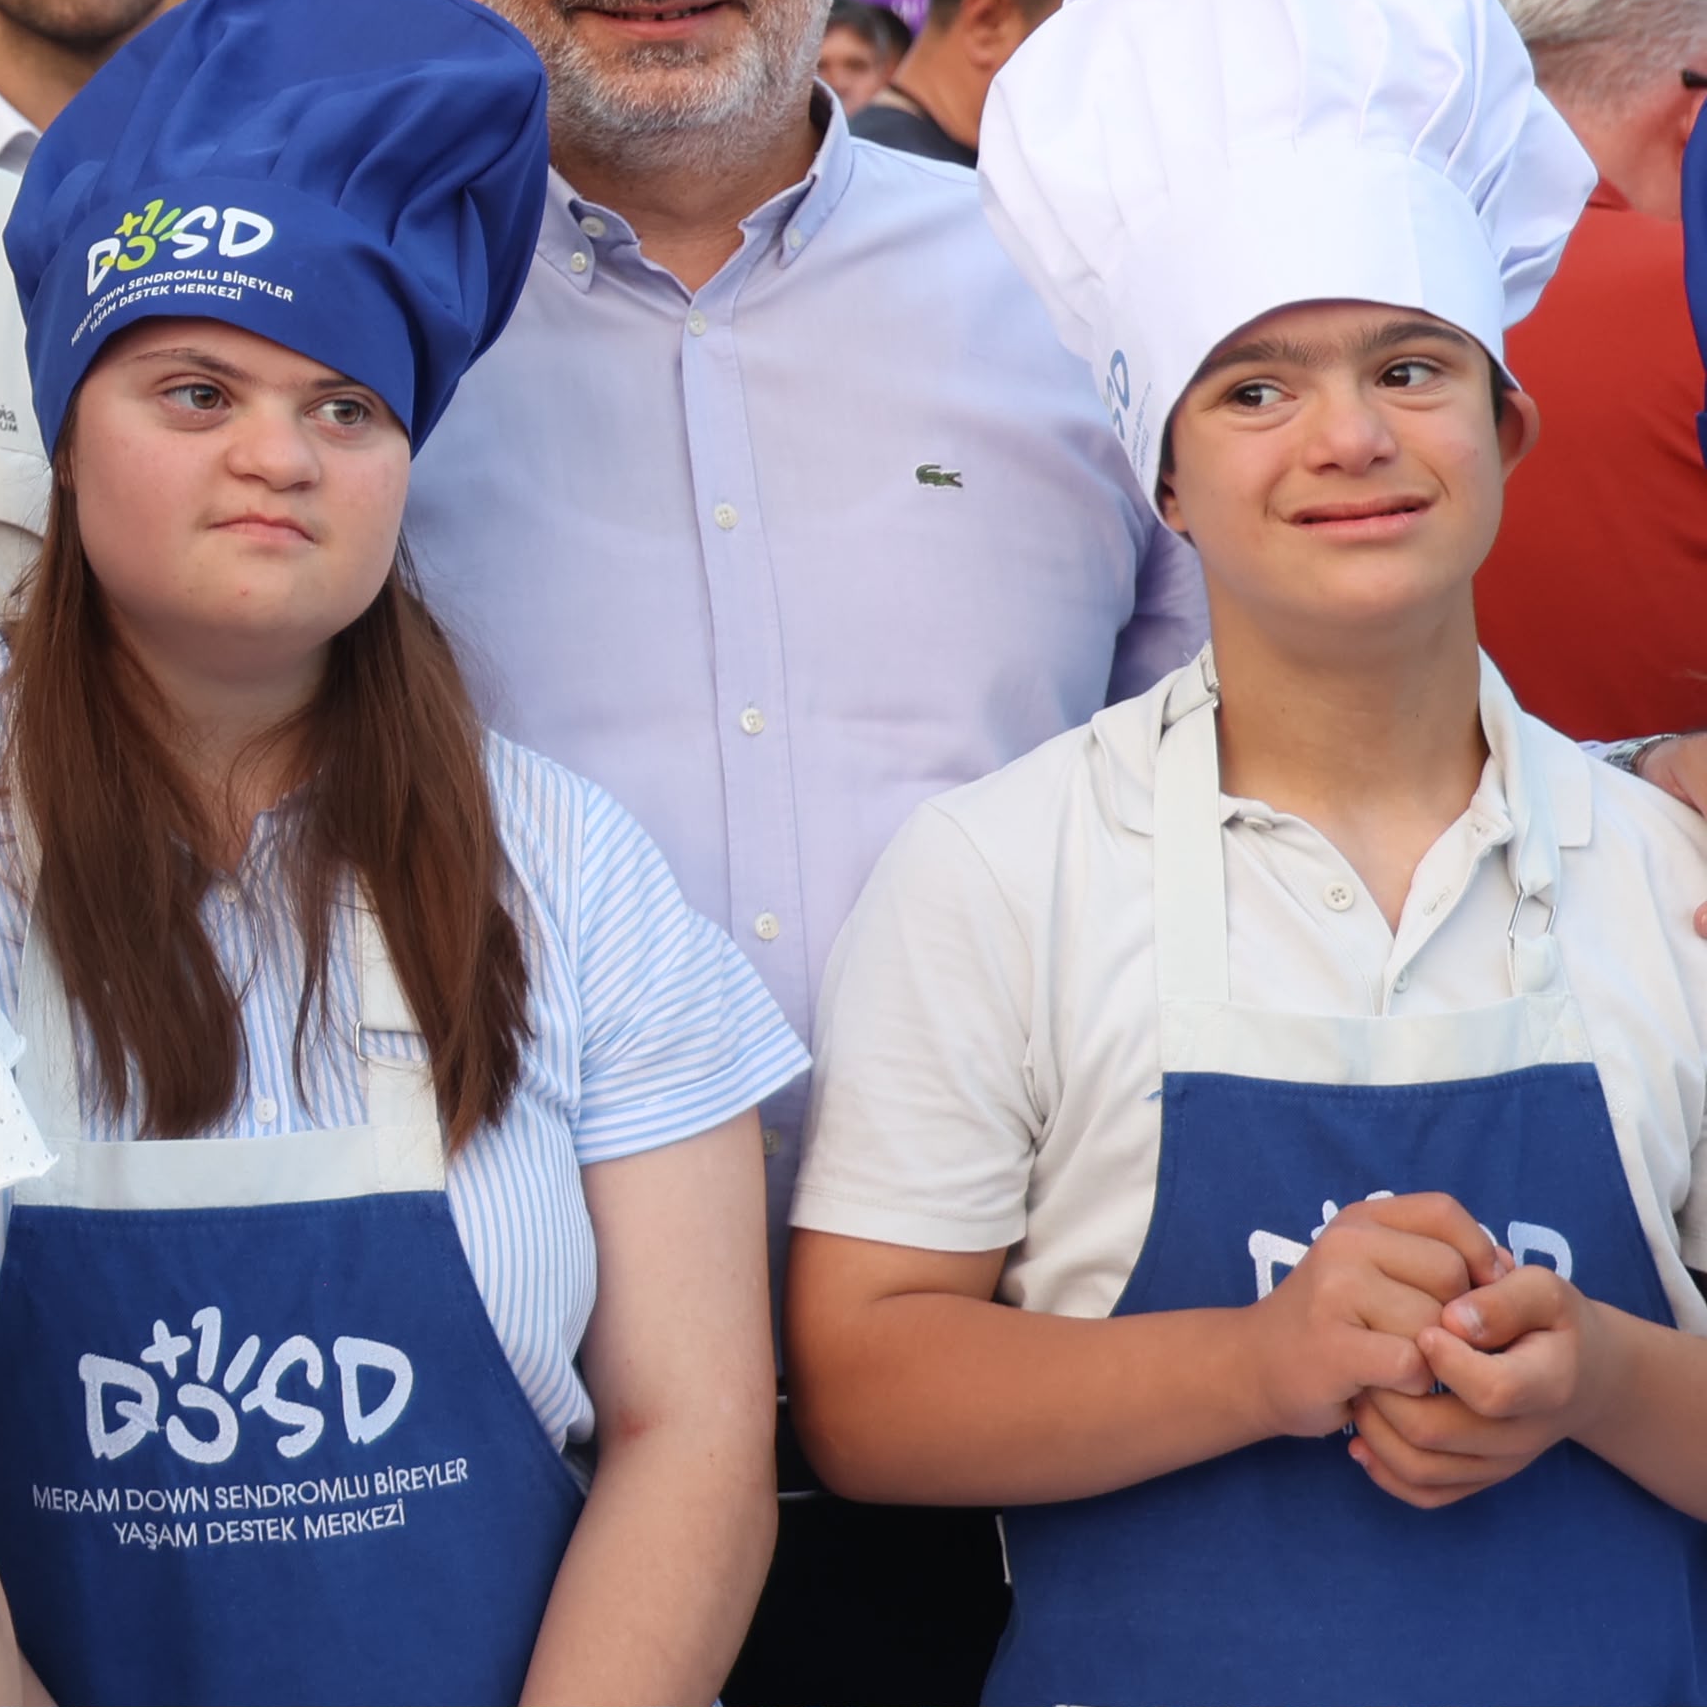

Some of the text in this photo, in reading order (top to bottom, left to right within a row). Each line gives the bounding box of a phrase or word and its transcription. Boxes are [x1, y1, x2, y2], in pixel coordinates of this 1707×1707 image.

[90, 282, 242, 333] YAŞAM DESTEK MERKEZİ
[92, 284, 125, 315] DOWN
[128, 269, 218, 290] SENDROMLU
[222, 269, 294, 303] BİREYLER
[32, 1457, 469, 1513] MERAM DOWN SENDROMLU BİREYLER
[113, 1498, 406, 1551] YAŞAM DESTEK MERKEZİ
